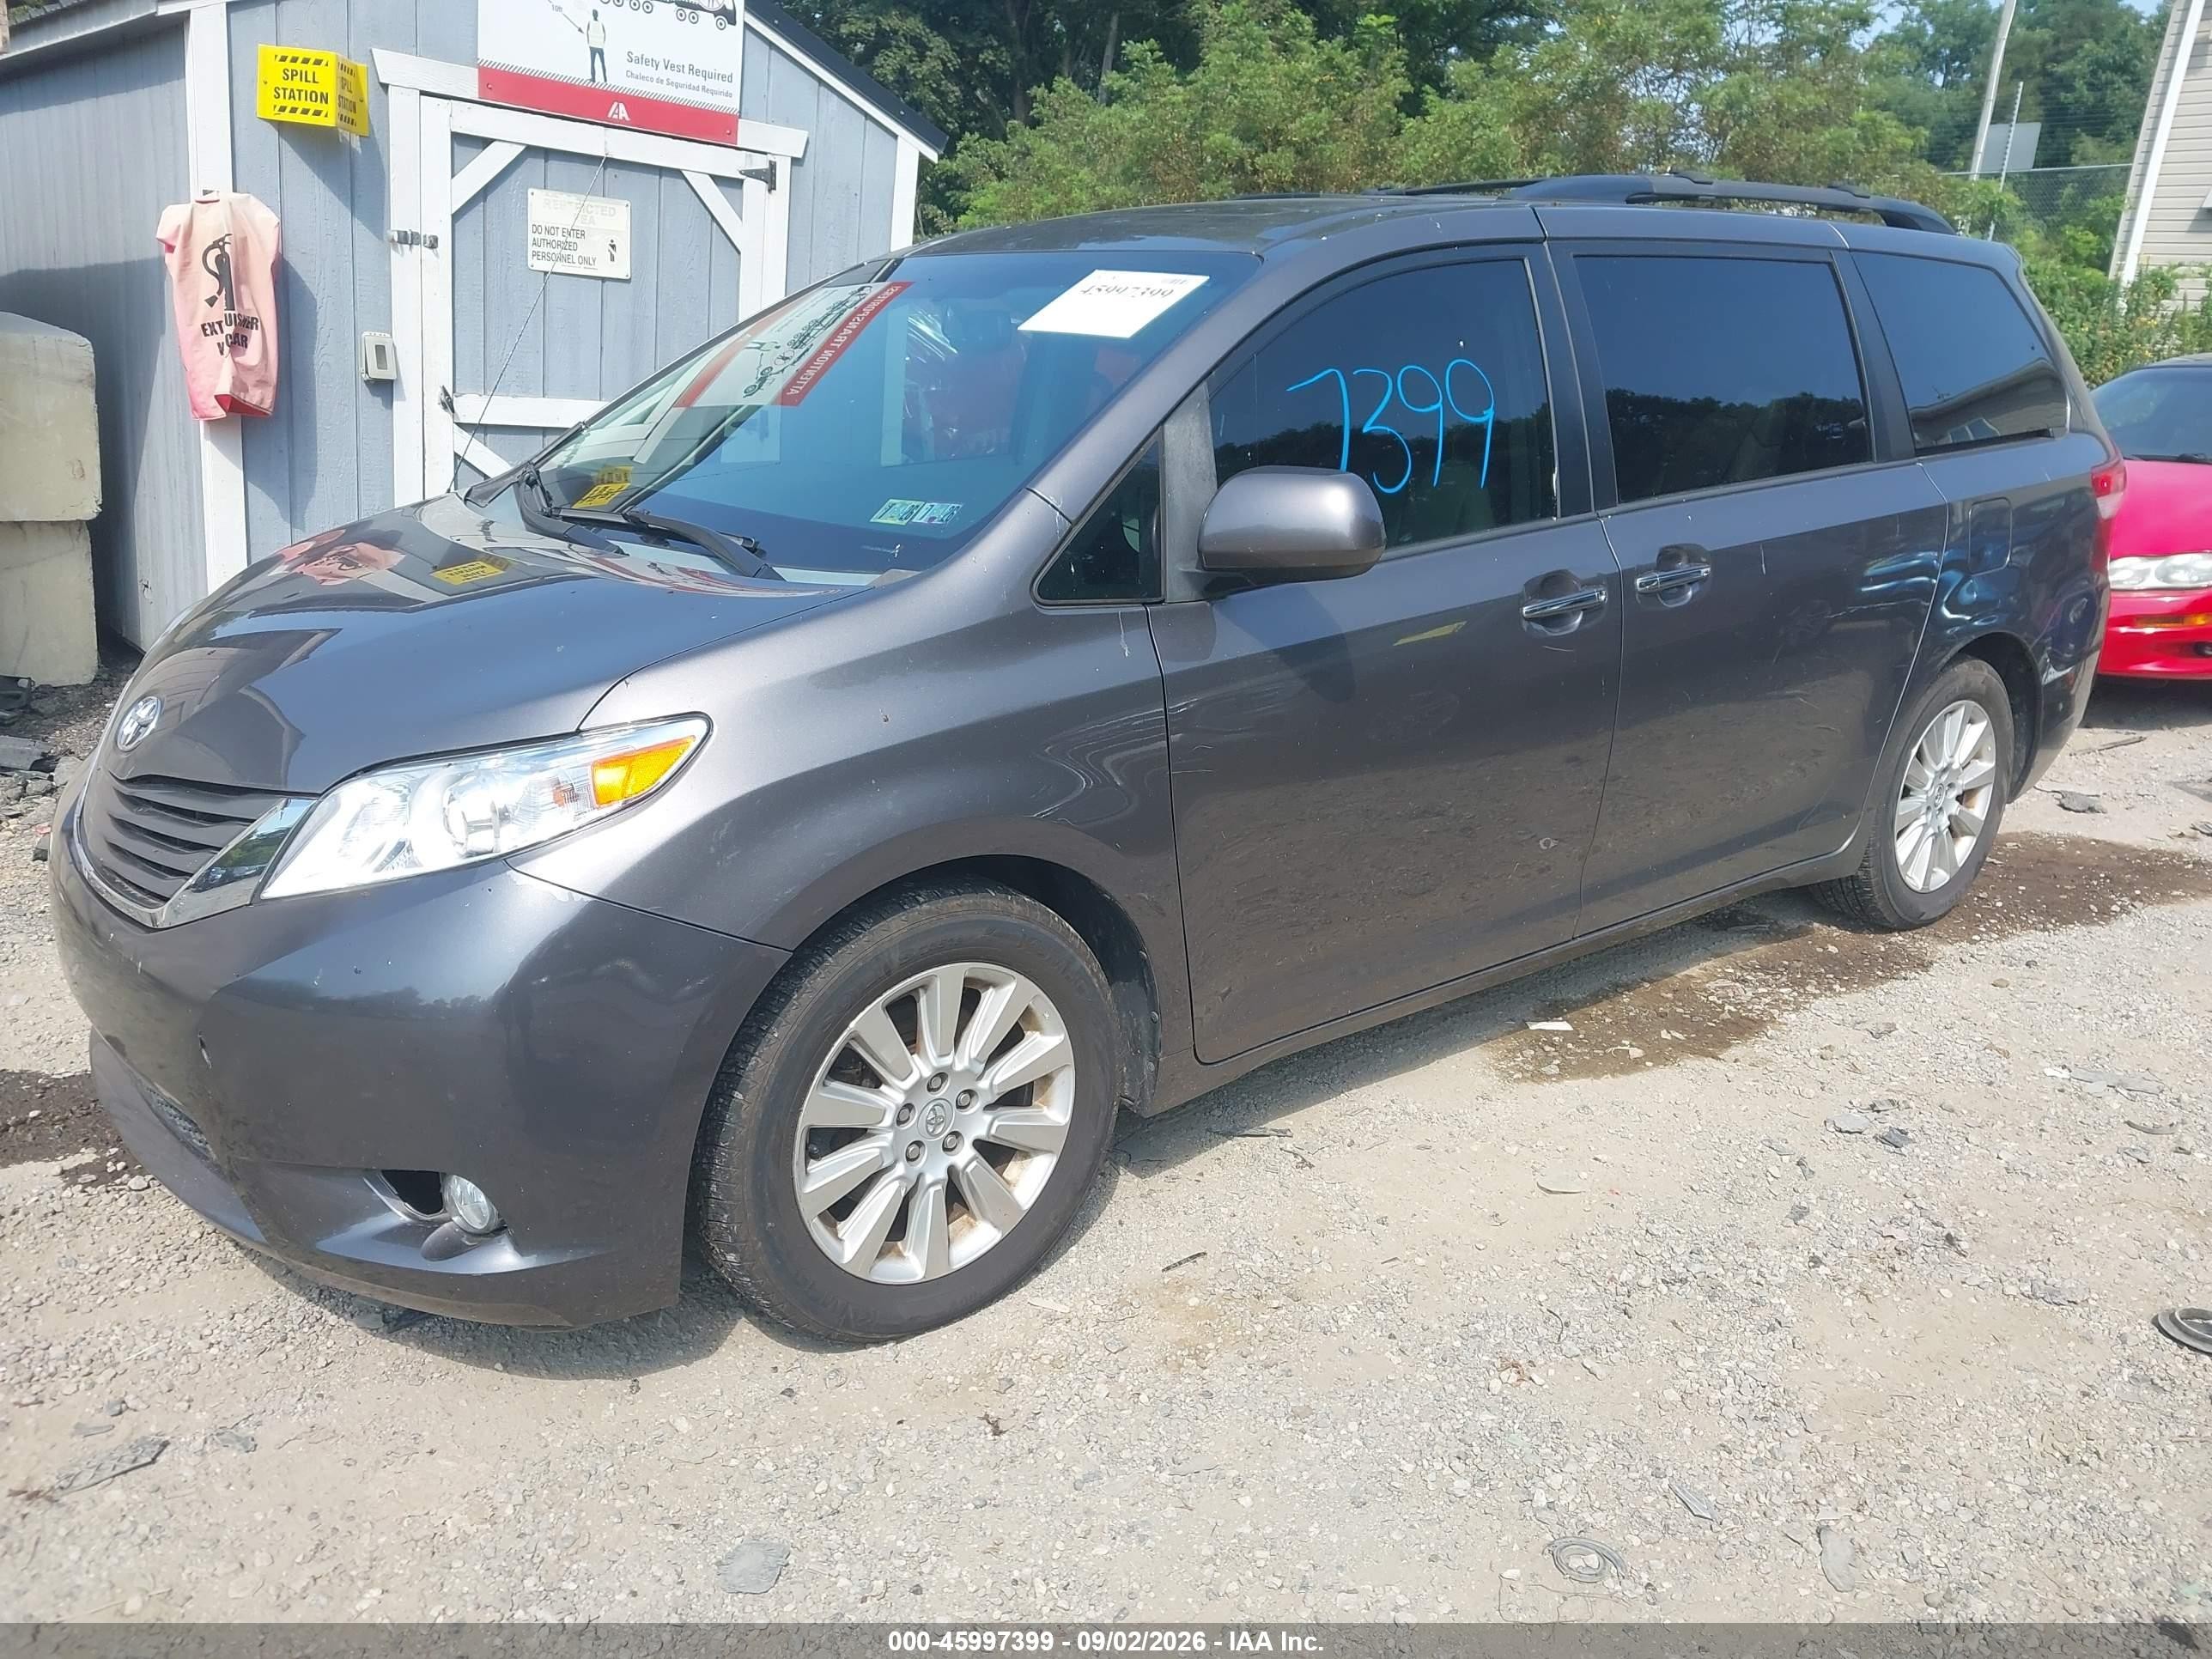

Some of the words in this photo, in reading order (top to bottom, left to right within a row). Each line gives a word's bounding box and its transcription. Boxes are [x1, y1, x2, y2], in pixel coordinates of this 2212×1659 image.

[626, 51, 660, 71] Safety
[663, 58, 686, 75] Vest
[688, 64, 733, 83] Required
[282, 68, 319, 84] SPILL
[625, 70, 654, 83] Chaleco
[656, 76, 665, 85] de
[665, 78, 700, 92] Seguridad
[702, 84, 733, 99] Requirido
[273, 86, 329, 105] STATION
[532, 224, 543, 235] DO
[544, 226, 560, 236] NOT
[562, 228, 586, 240] ENTER
[532, 237, 578, 252] AUTHORIZED
[532, 251, 576, 264] PERSONNEL
[577, 255, 598, 266] ONLY
[1286, 358, 1495, 494] 7399
